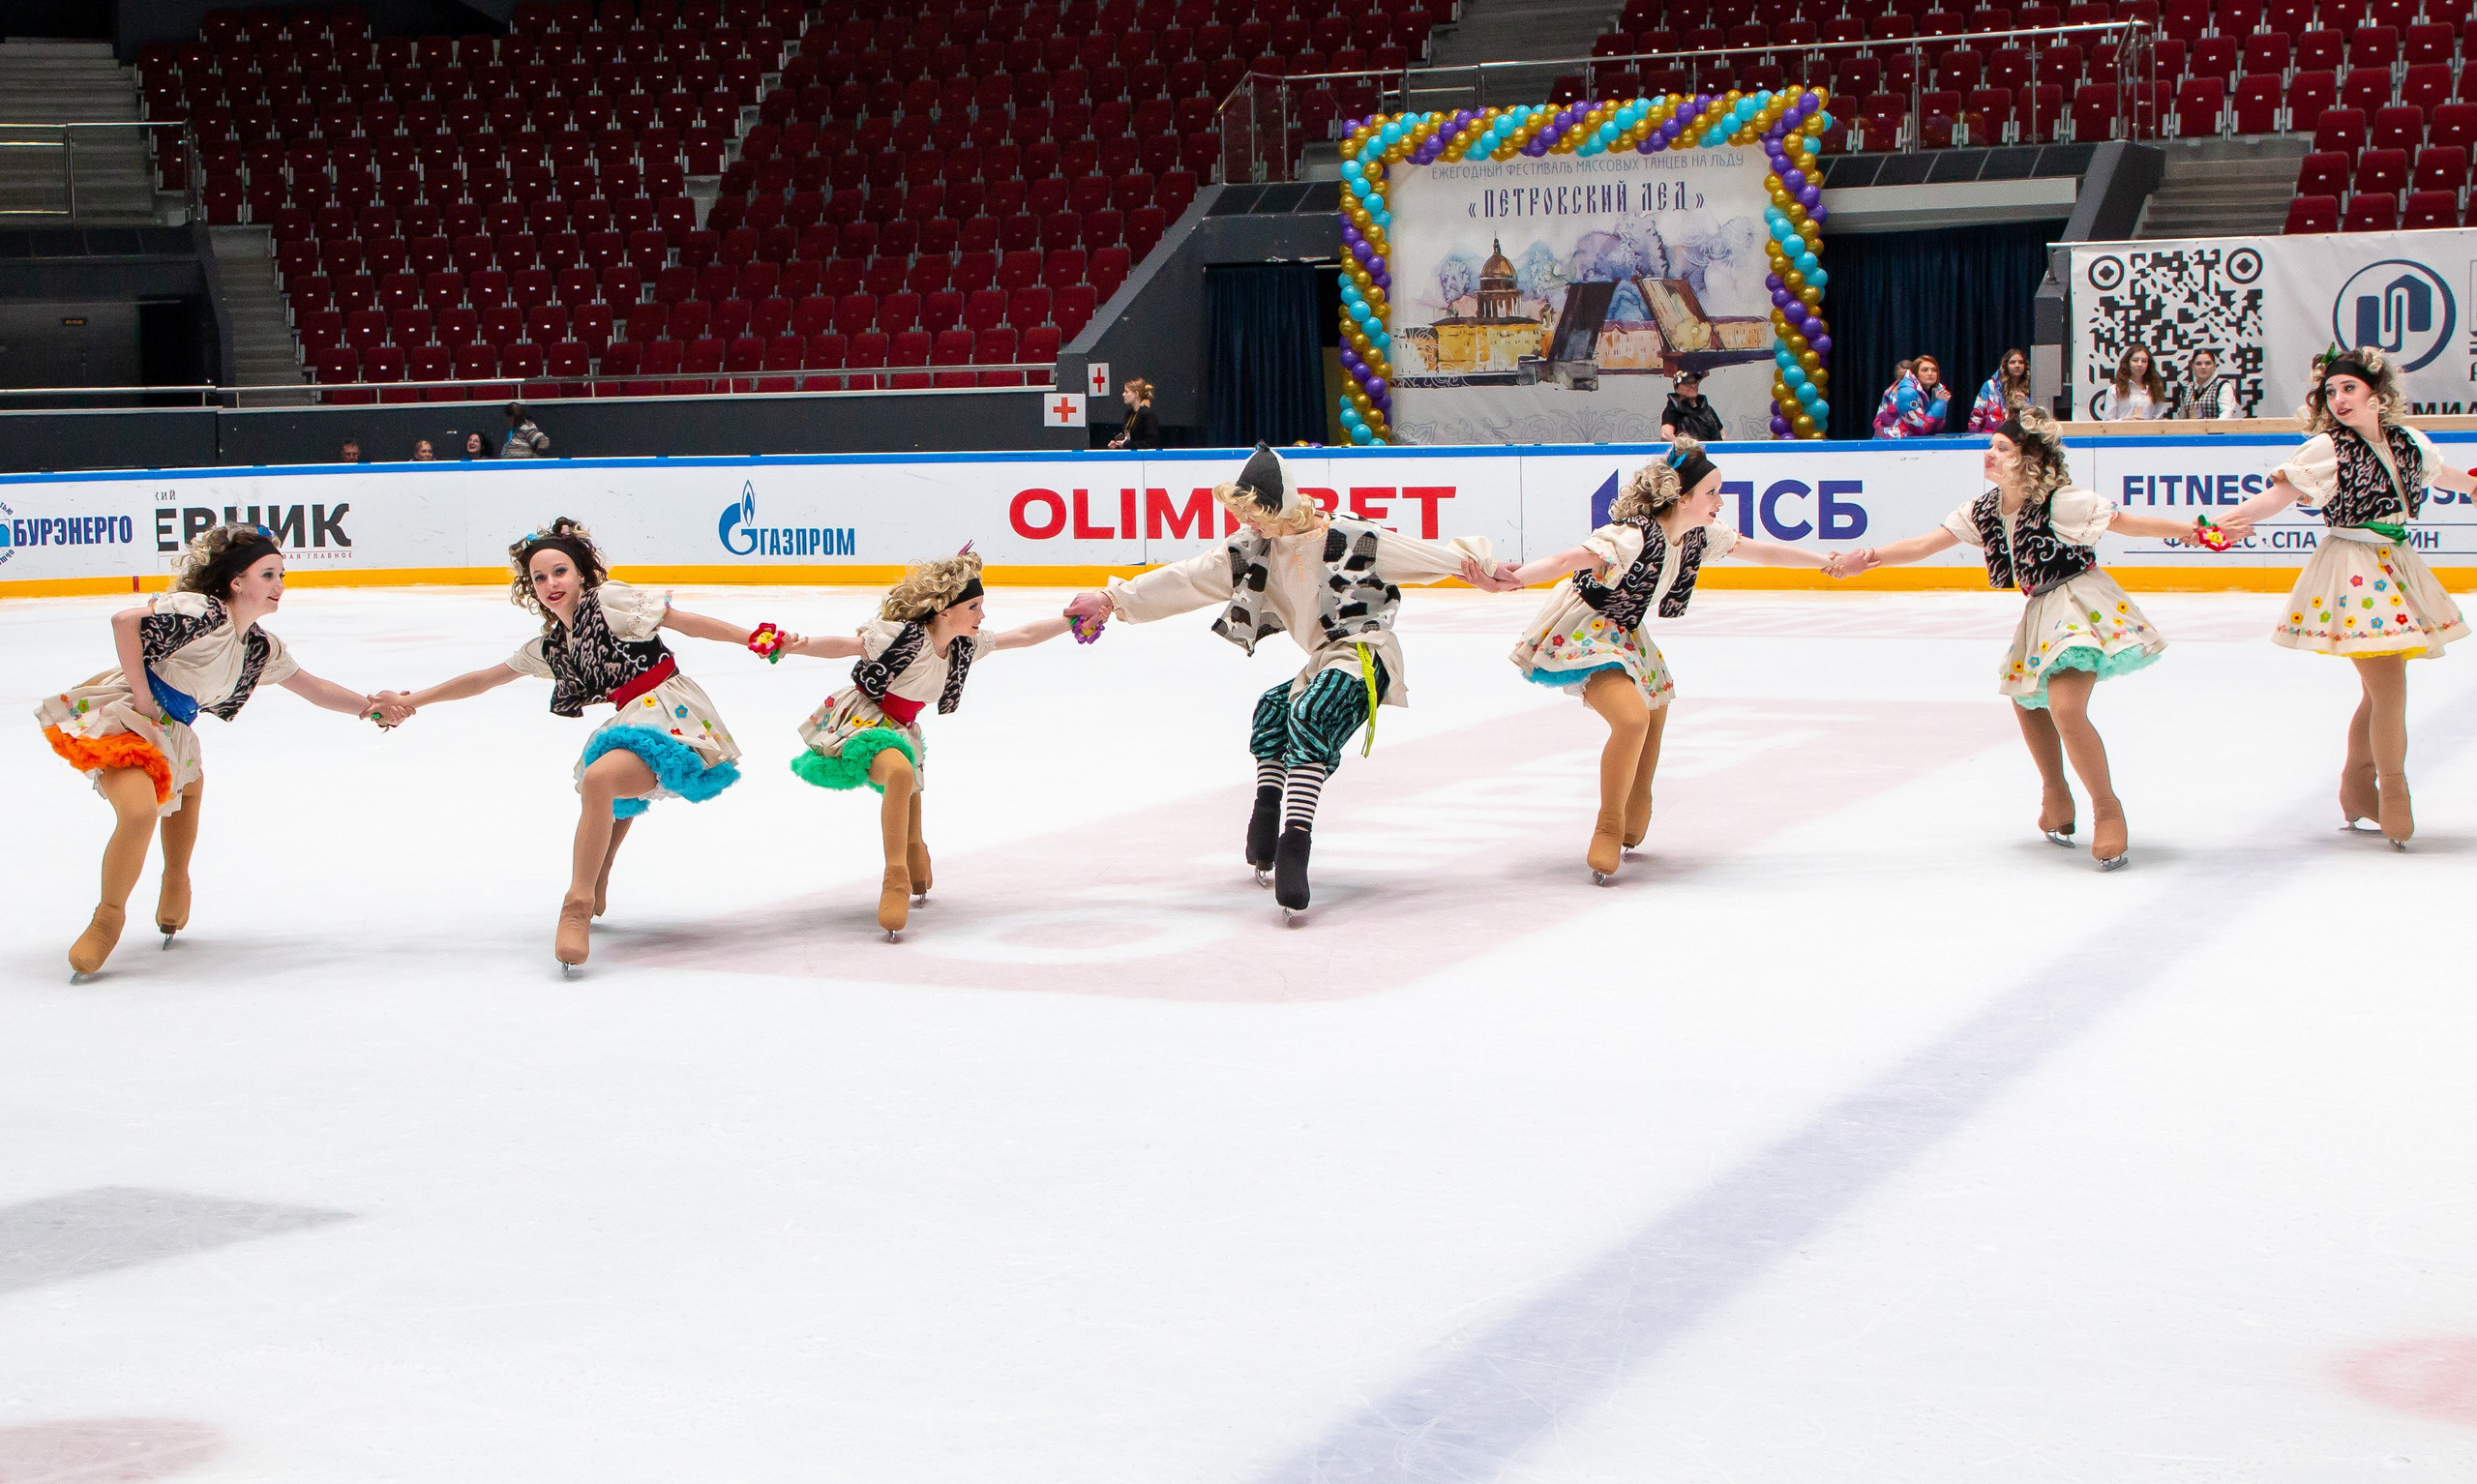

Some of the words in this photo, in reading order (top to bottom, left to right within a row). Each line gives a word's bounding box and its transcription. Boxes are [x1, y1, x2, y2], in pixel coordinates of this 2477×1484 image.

[1431, 163, 1502, 180] ЕЖЕГОДНЫЙ
[1506, 160, 1573, 176] ФЕСТИВАЛЬ
[1576, 158, 1639, 173] МАССОВЫХ
[1643, 155, 1687, 170] ТАНЦЕВ
[1691, 154, 1707, 167] НА
[1711, 153, 1744, 167] ЛЬДУ
[2123, 474, 2276, 506] FITNES
[1009, 486, 1457, 540] OLIMET
[13, 515, 133, 547] БУРЭНЕРГО
[760, 528, 855, 555] ГАЗПРОМ
[2272, 530, 2317, 549] СПА
[307, 551, 353, 560] ГЛАВНОЕ
